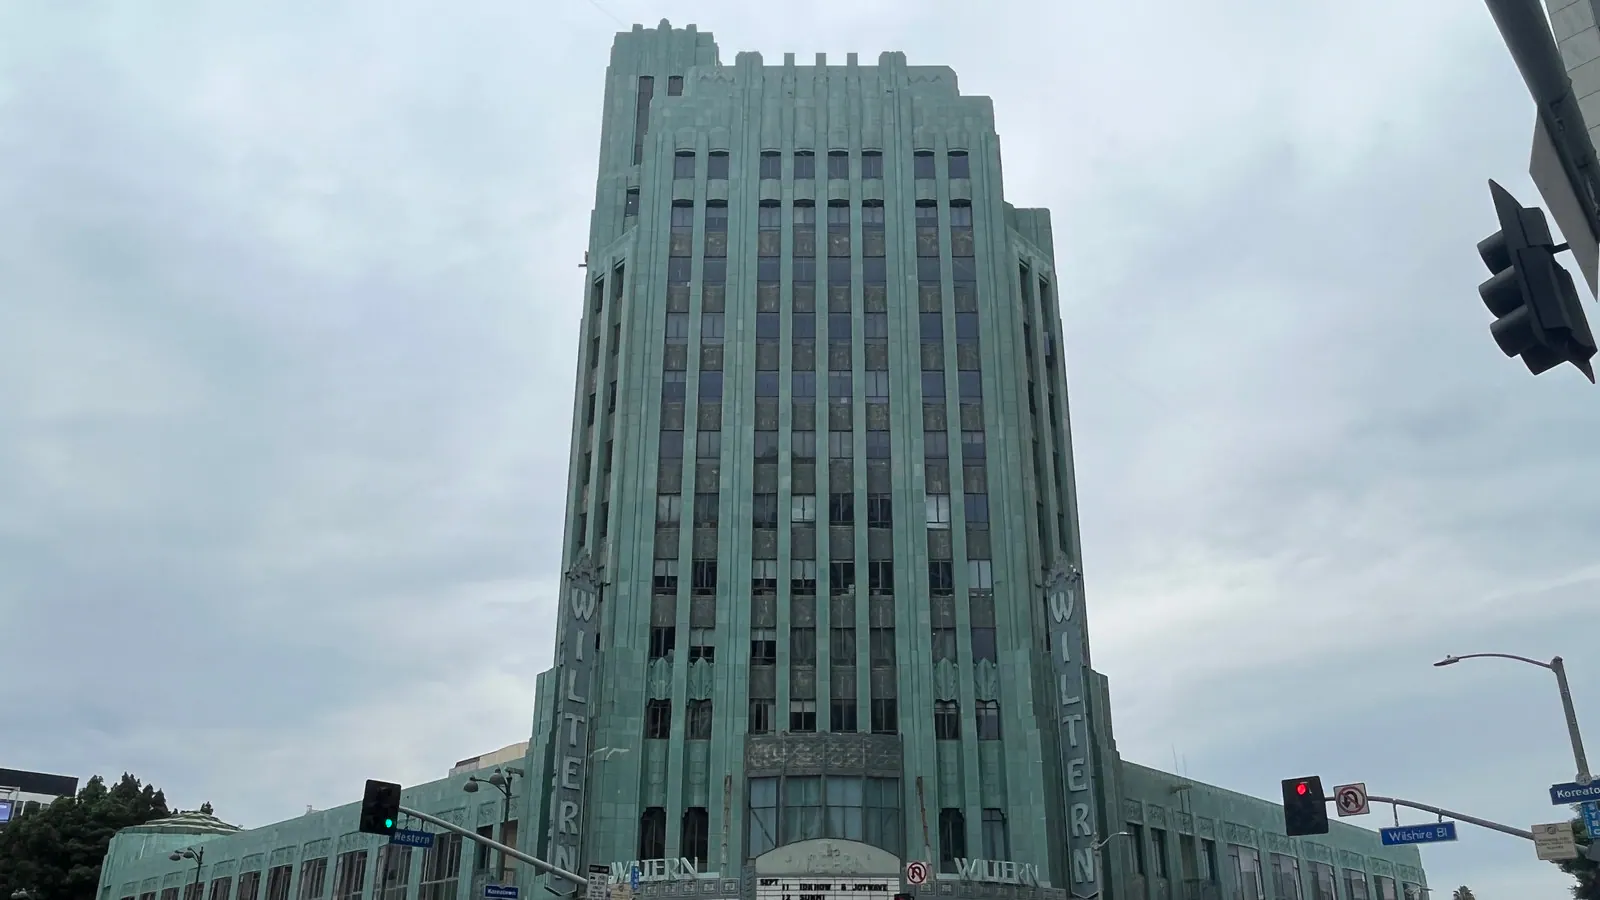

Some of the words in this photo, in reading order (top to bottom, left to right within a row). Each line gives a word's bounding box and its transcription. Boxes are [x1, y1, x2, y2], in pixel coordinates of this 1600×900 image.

[555, 587, 595, 880] WILTERN
[1050, 589, 1094, 883] WILTERN
[395, 831, 430, 844] Western
[1389, 829, 1433, 841] Wilshire
[1436, 827, 1448, 837] Bl
[954, 857, 1040, 888] WILTERN
